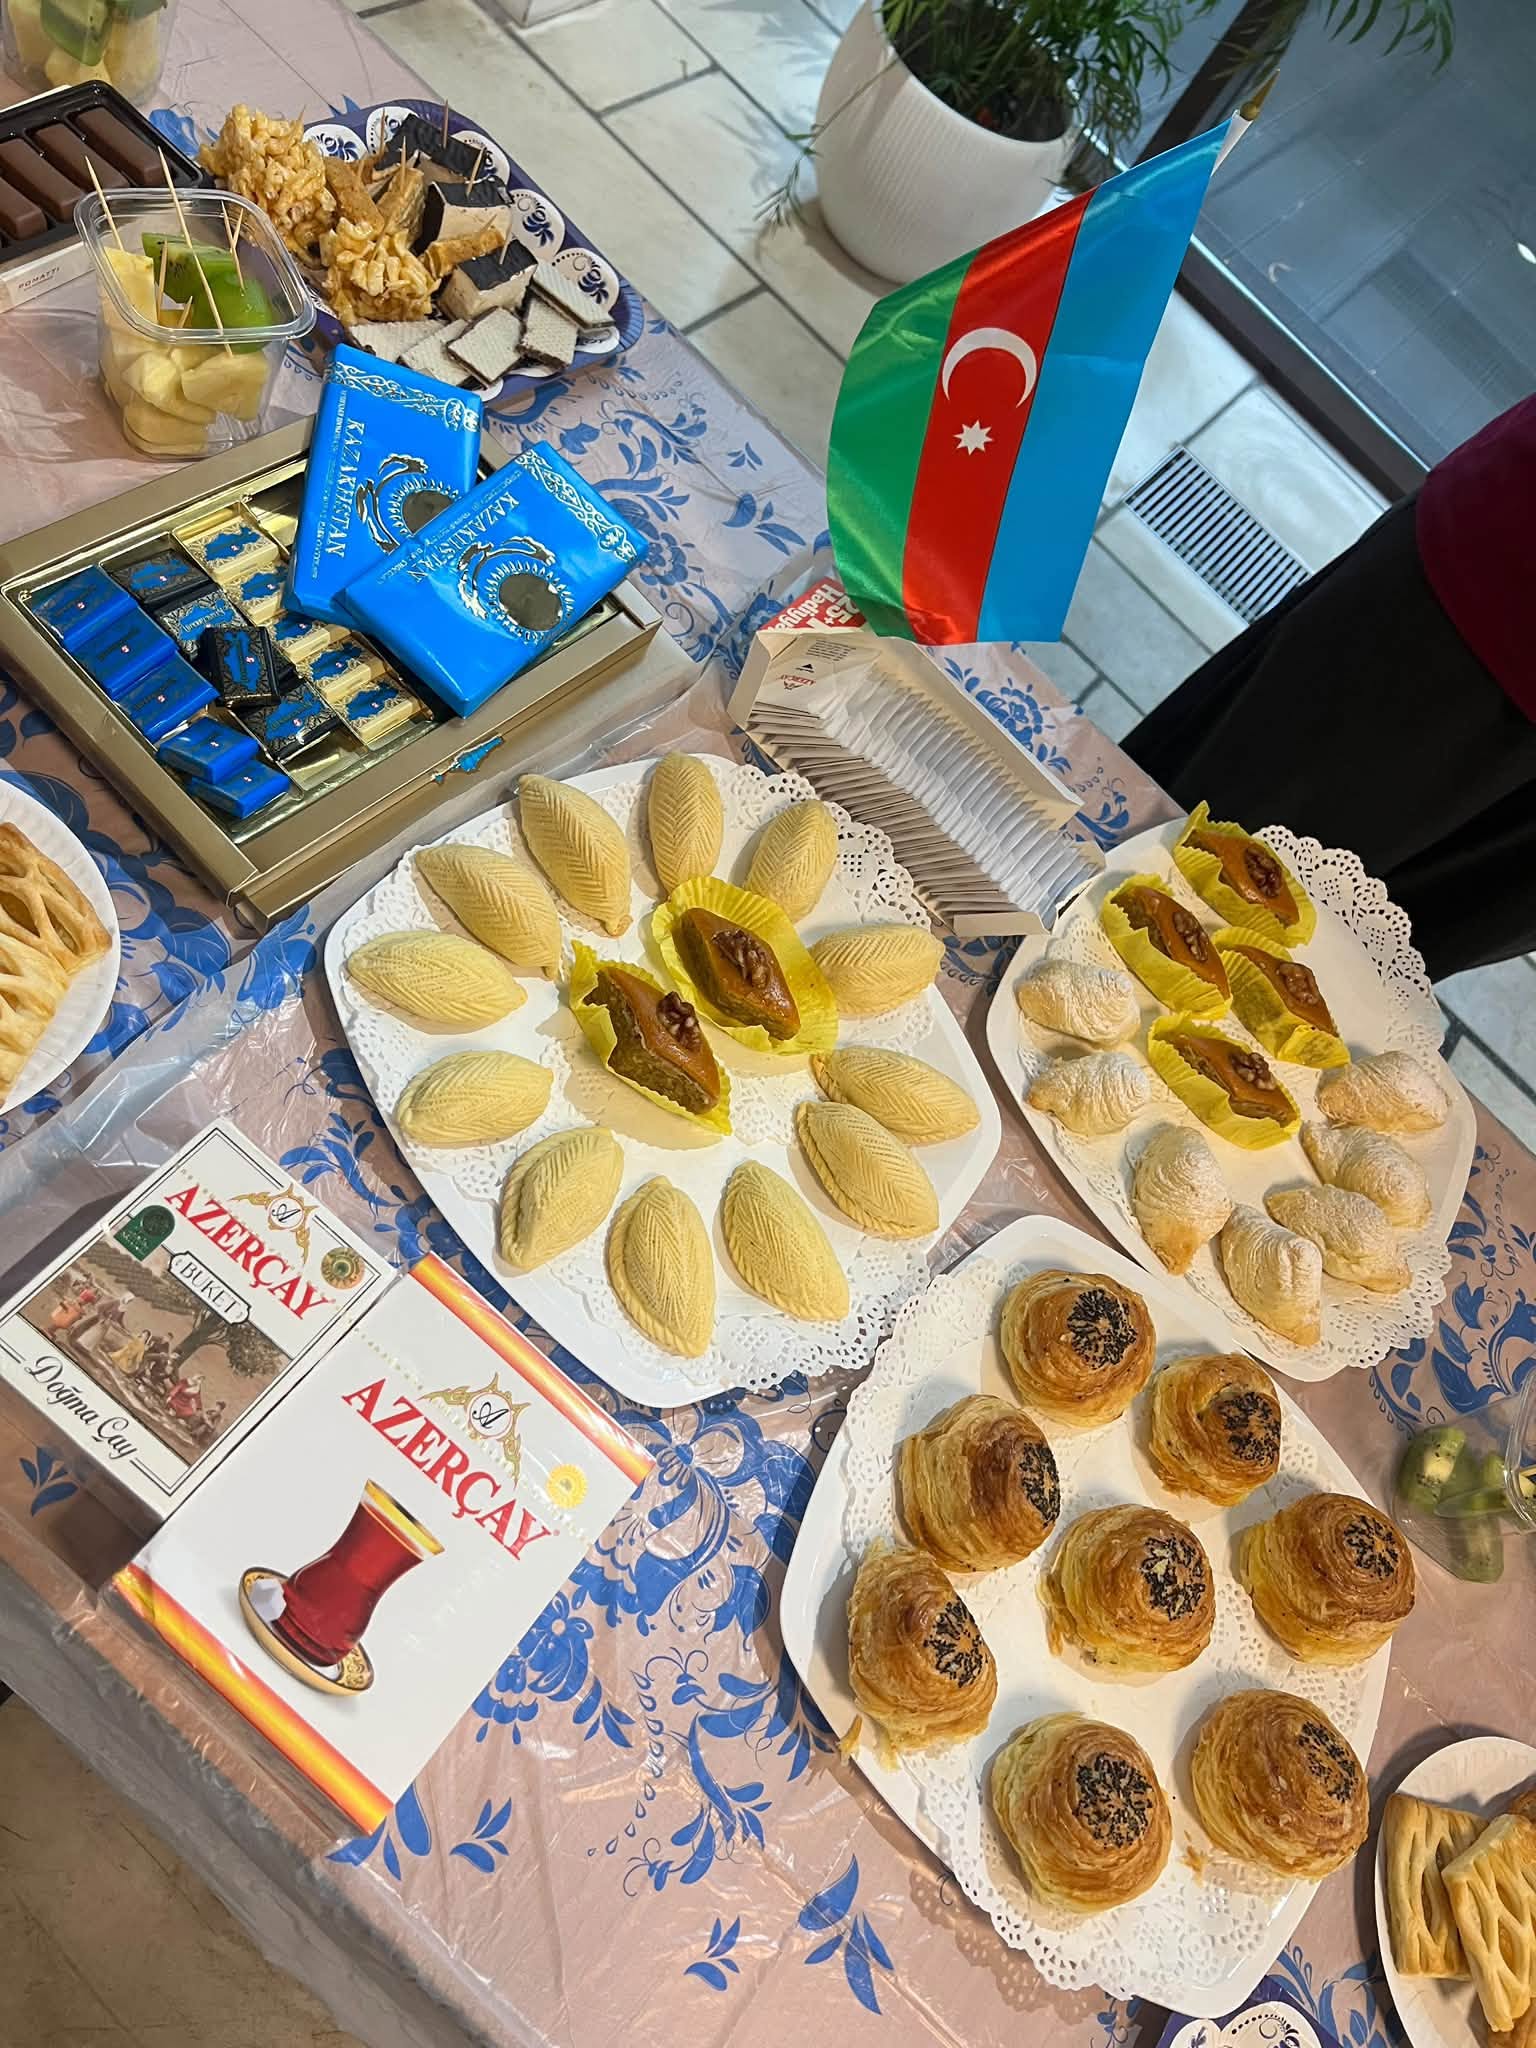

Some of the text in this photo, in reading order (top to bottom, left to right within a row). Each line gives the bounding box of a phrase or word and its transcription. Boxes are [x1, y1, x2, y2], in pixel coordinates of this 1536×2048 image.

[325, 418, 366, 558] KAZAKHSTAN
[407, 491, 520, 584] KAZAKHSTAN
[164, 1184, 330, 1320] AZERÇAY
[178, 1262, 241, 1315] BUKET
[91, 1416, 138, 1460] Çay
[341, 1378, 552, 1561] AZERÇAY
